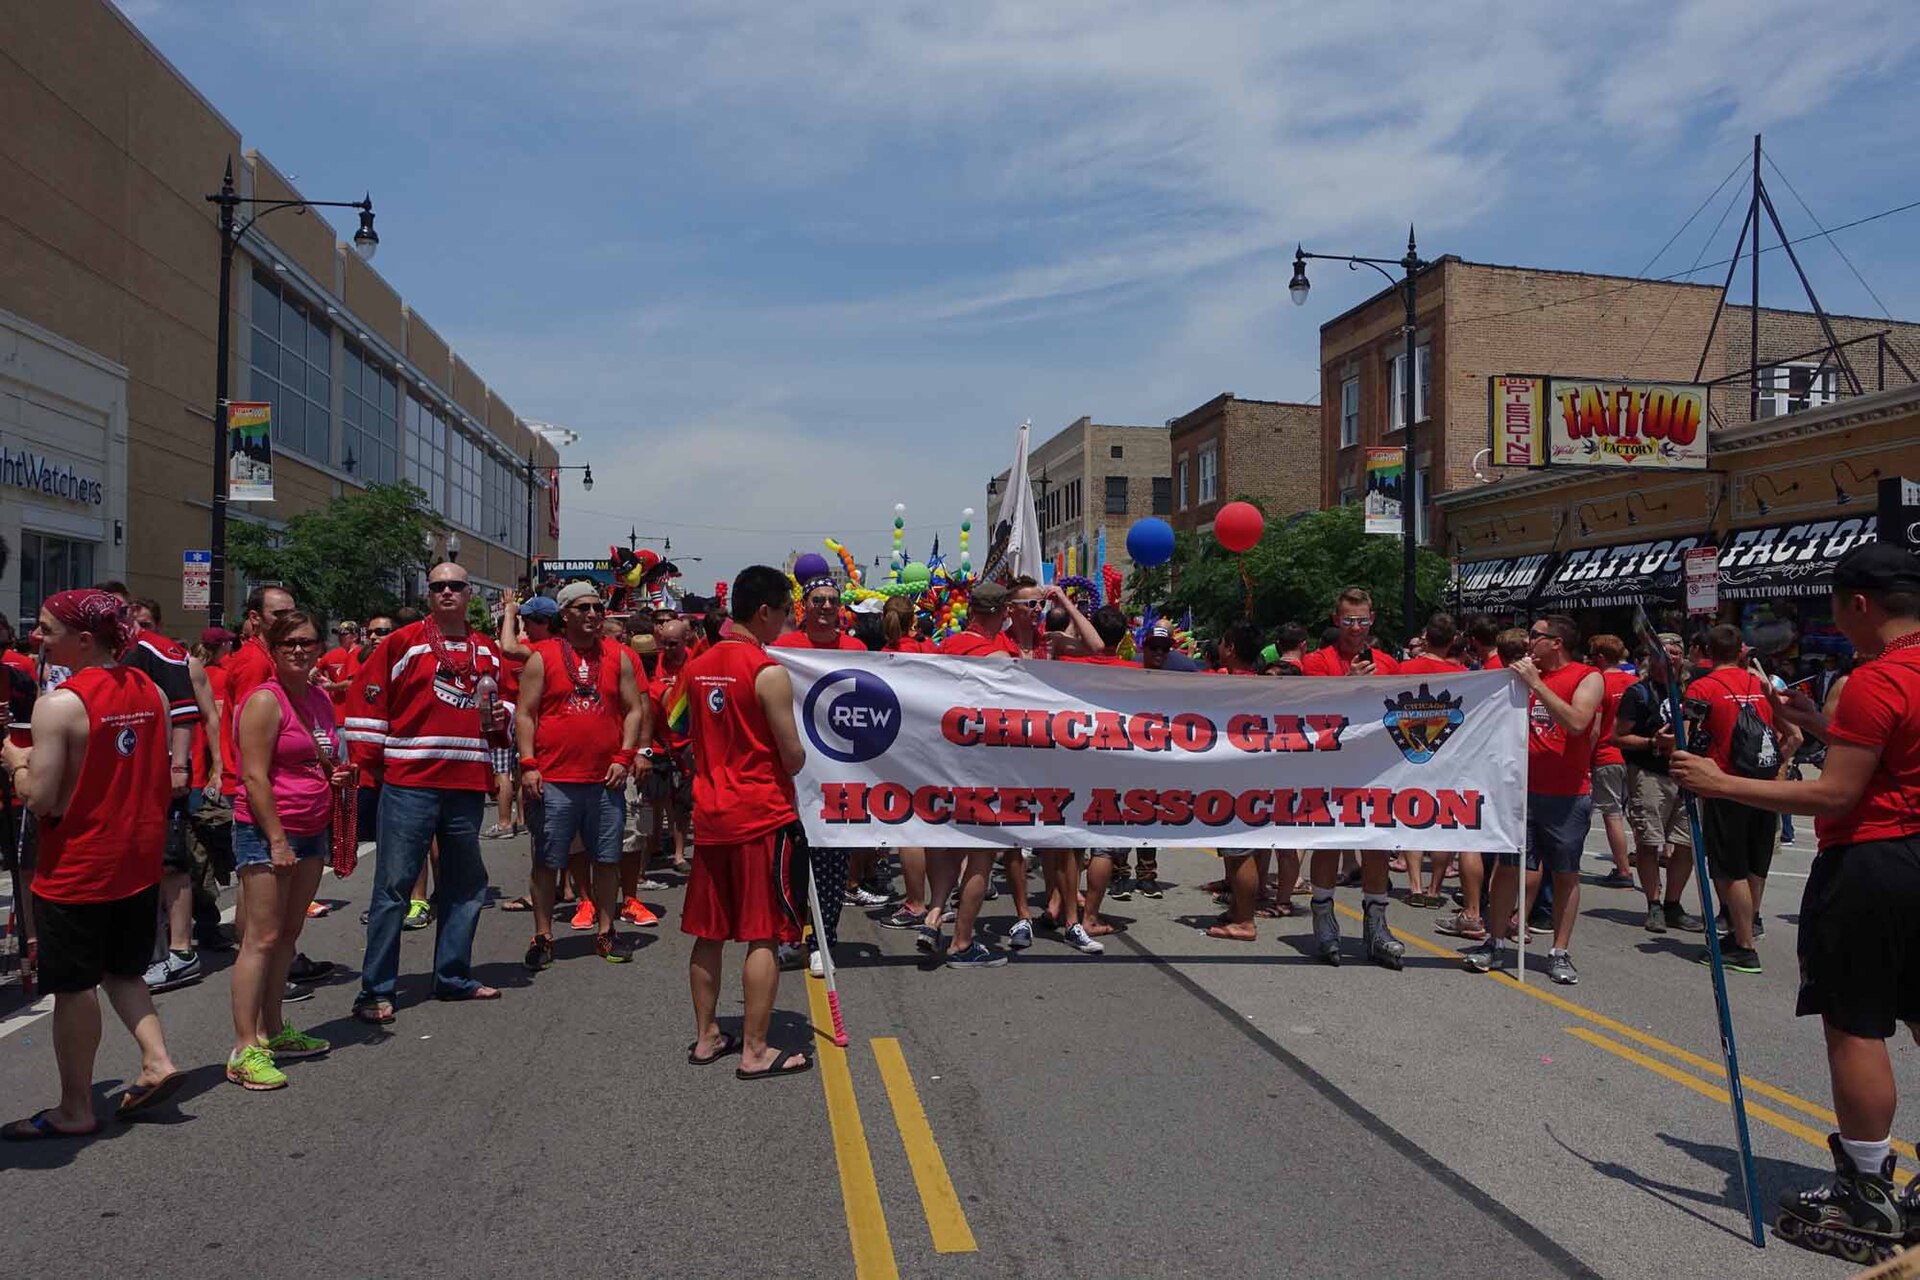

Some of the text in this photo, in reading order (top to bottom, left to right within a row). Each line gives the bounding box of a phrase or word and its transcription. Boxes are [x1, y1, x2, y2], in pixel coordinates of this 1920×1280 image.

[1506, 385, 1530, 464] PIERCING
[1556, 384, 1702, 446] TATTOO
[1603, 442, 1654, 455] FACTORY
[543, 562, 609, 570] WGN RADIO AM
[1500, 554, 1549, 588] INK
[1591, 594, 1644, 608] BROADWAY
[941, 706, 1349, 752] CHICAGO GAY
[820, 782, 1483, 830] HOCKEY ASSOCIATION
